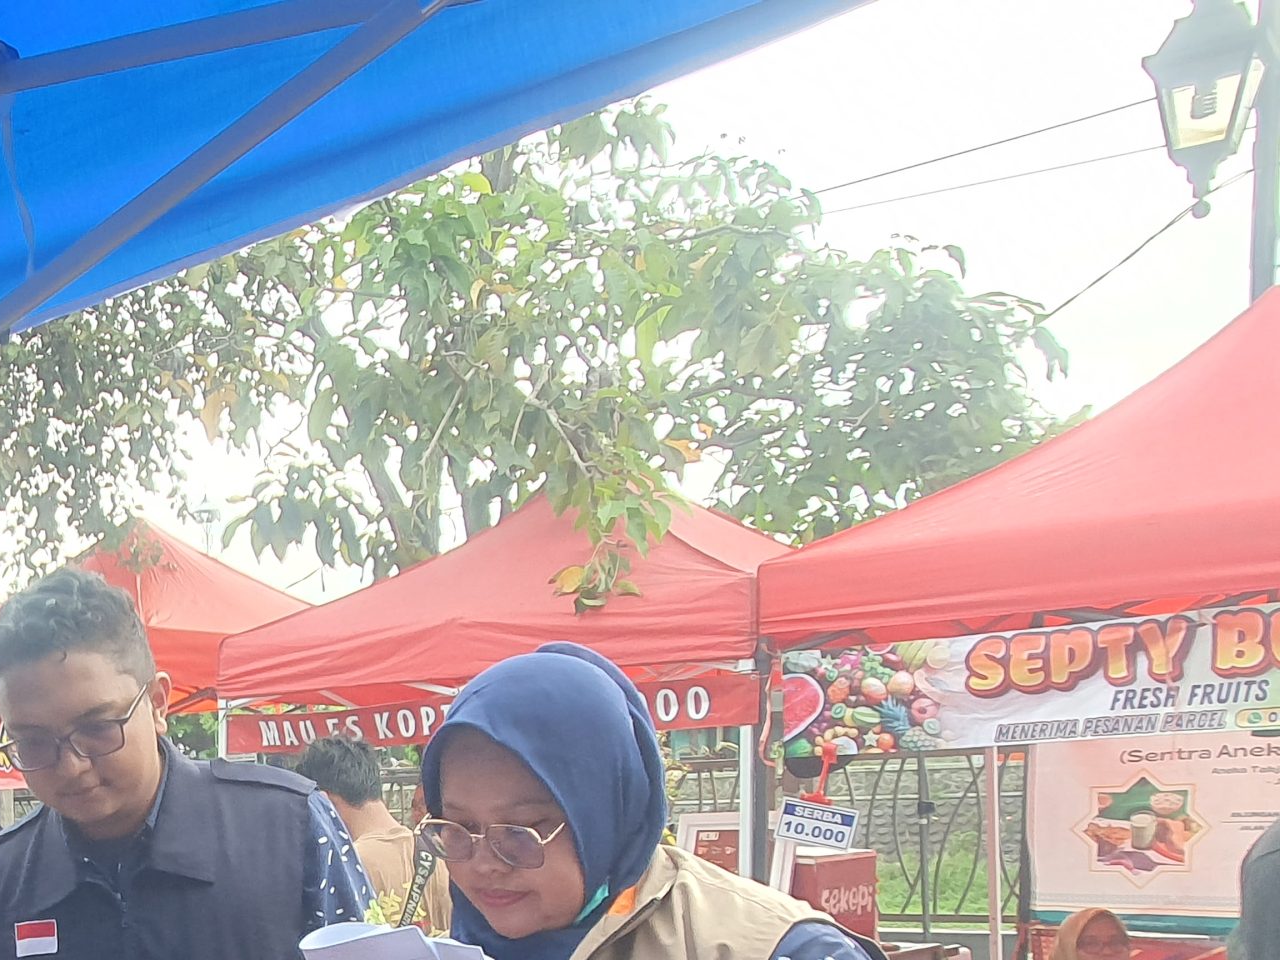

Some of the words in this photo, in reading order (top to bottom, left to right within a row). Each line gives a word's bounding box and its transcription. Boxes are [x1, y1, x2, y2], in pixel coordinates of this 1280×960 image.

[966, 615, 1194, 697] SEPTY
[1212, 608, 1280, 678] B
[1110, 686, 1179, 711] FRESH
[1187, 680, 1269, 706] FRUITS
[259, 719, 317, 746] MAU
[638, 686, 709, 722] 00
[995, 719, 1079, 742] MENERIMA
[1081, 713, 1160, 738] PESANAN
[1120, 747, 1211, 764] (Sentra
[794, 806, 842, 824] SERBA
[784, 820, 846, 843] 10.000
